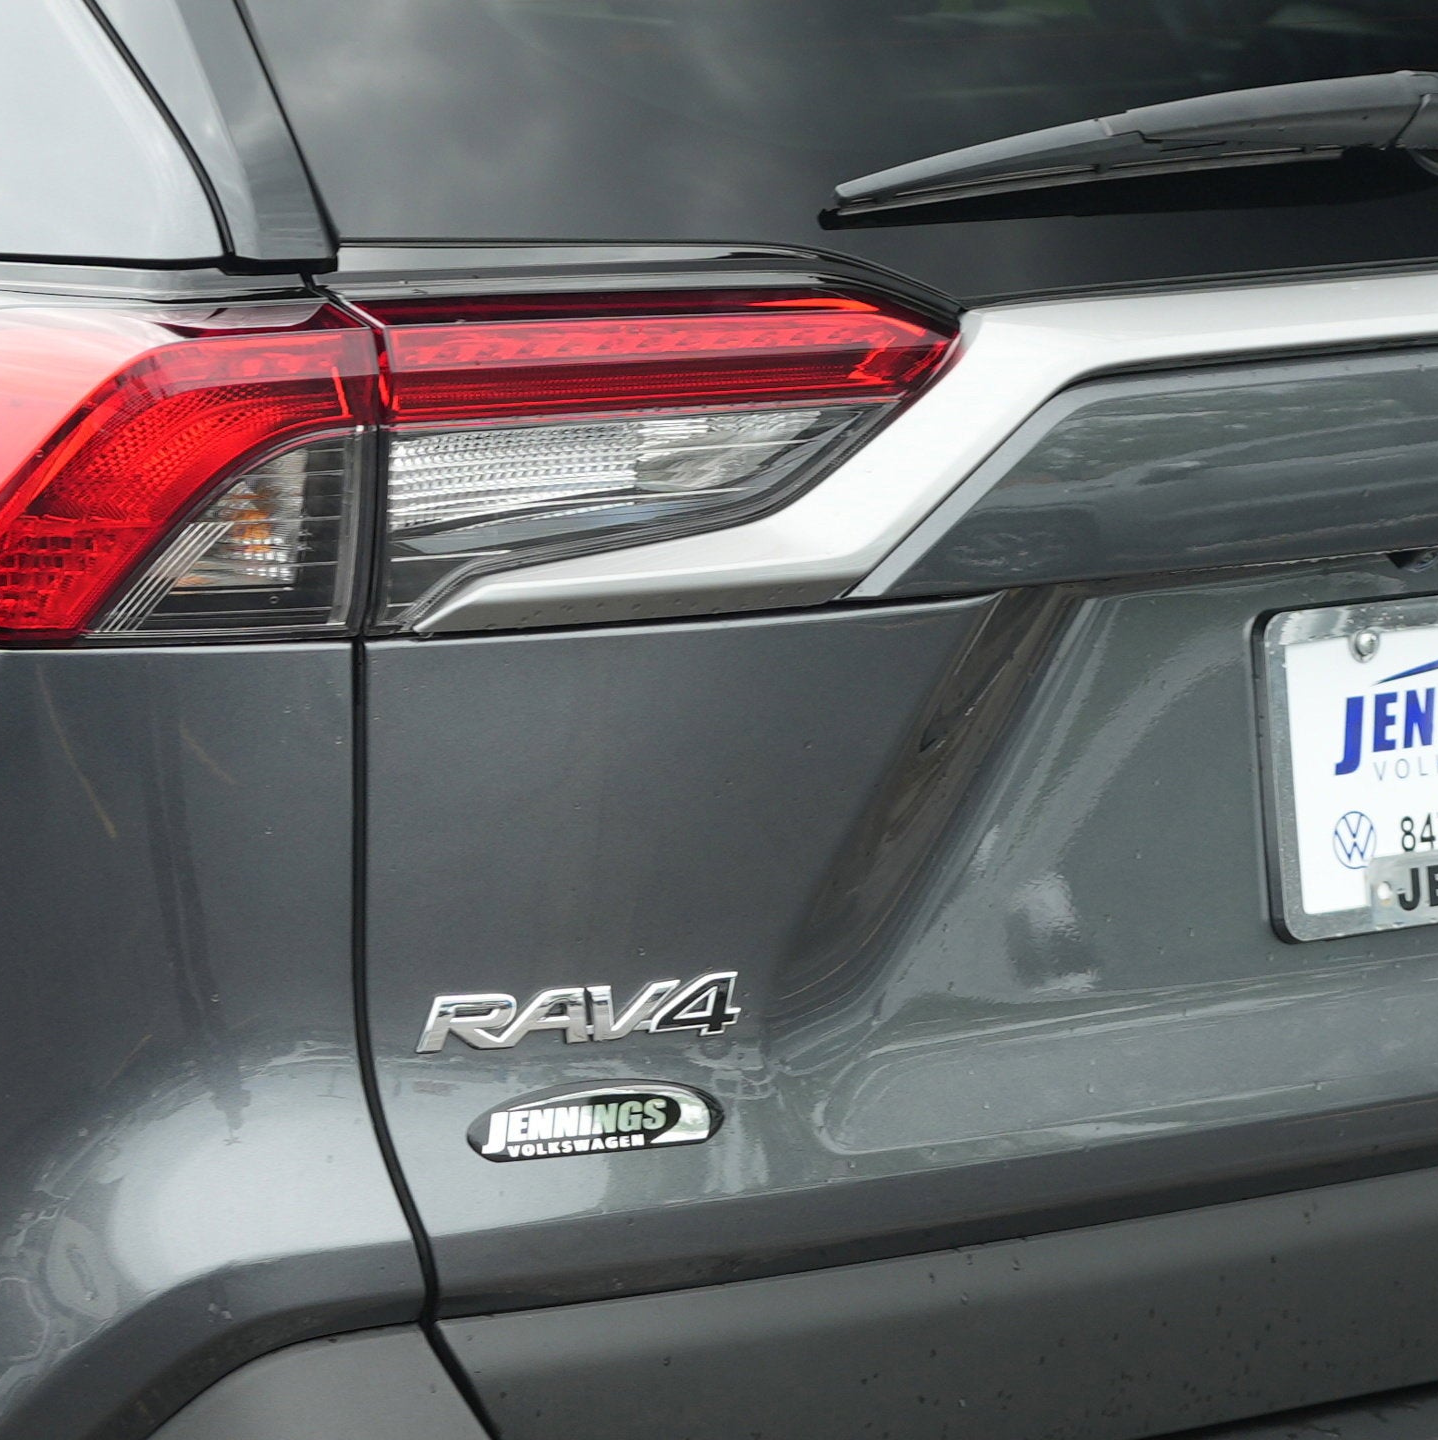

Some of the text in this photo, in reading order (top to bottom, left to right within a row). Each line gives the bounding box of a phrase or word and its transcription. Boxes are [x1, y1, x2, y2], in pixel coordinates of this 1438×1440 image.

[415, 970, 742, 1054] RAV4
[481, 1098, 668, 1155] JENNINGS
[506, 1133, 646, 1158] VOLKSWAGEN
